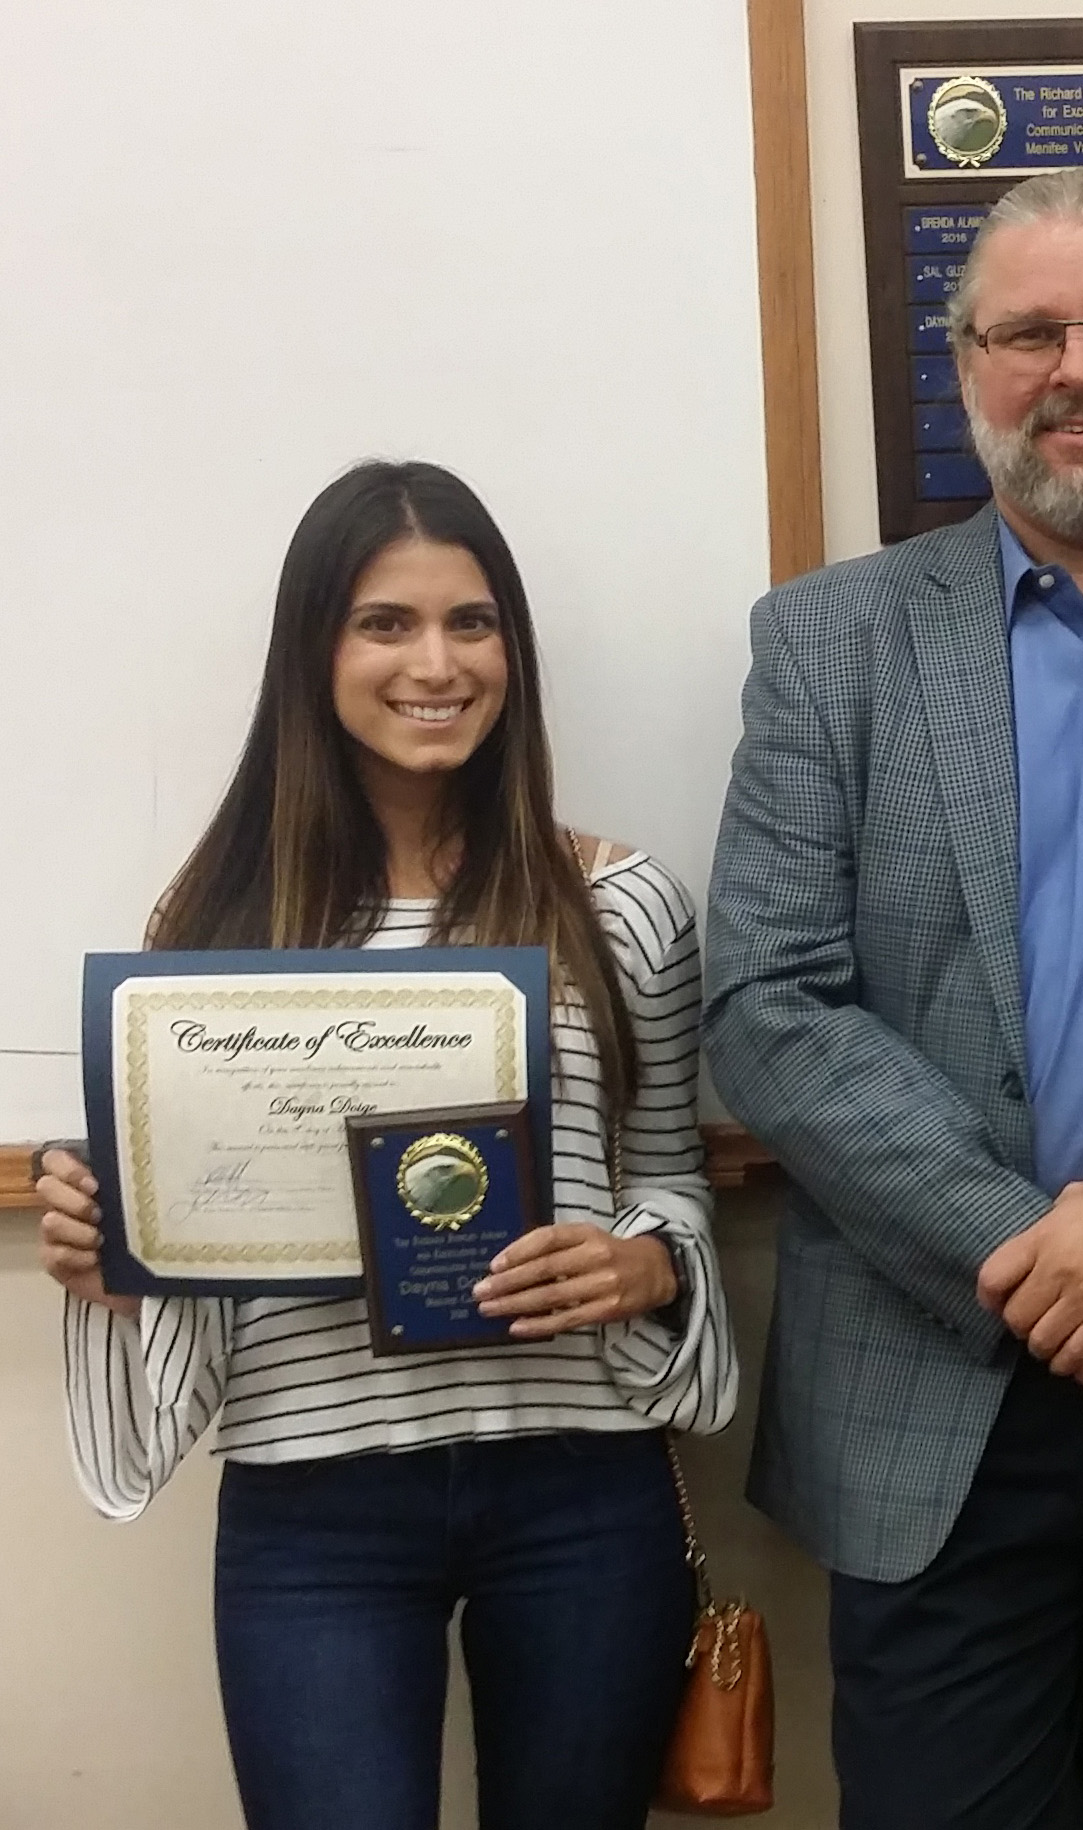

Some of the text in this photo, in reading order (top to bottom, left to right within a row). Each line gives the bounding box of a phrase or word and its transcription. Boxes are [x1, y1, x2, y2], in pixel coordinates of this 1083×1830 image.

[1014, 87, 1035, 101] The
[1040, 86, 1082, 100] Richard
[1042, 105, 1057, 118] for
[923, 265, 942, 278] SAL
[170, 1019, 472, 1062] Certificate of Excellence
[268, 1096, 326, 1121] Dayna
